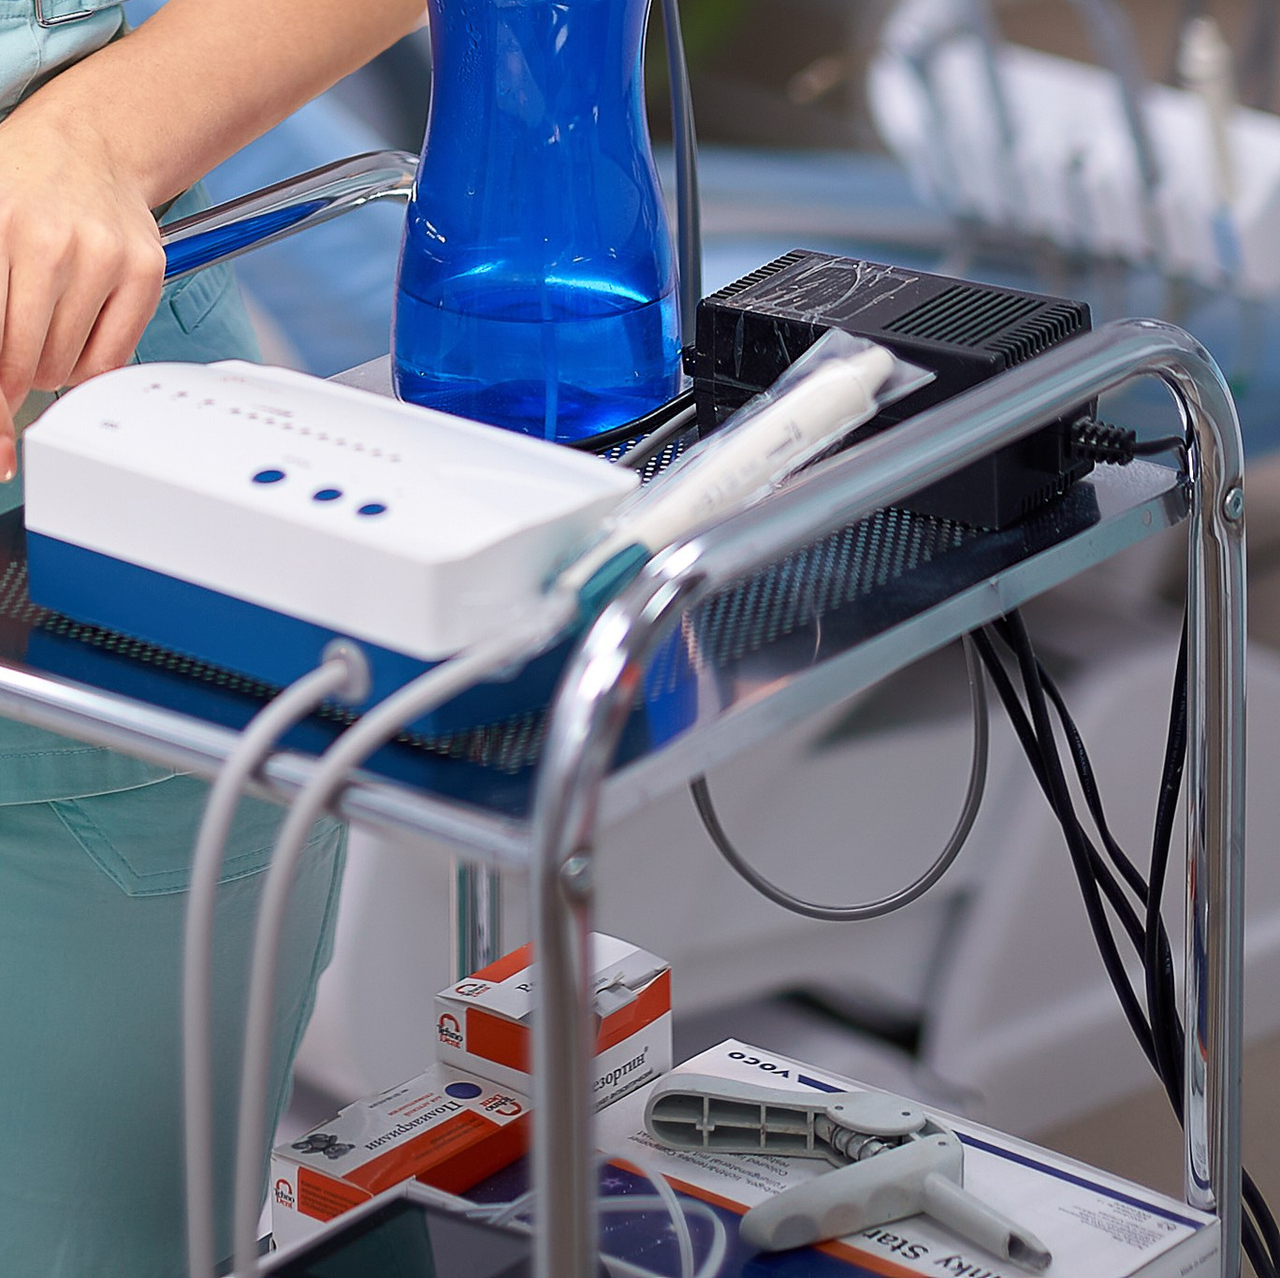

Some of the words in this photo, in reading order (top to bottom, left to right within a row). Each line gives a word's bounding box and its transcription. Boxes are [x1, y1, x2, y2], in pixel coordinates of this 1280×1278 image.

[592, 1052, 645, 1093] езортин
[364, 1100, 464, 1151] Полиакрилин
[863, 1229, 929, 1260] Star
